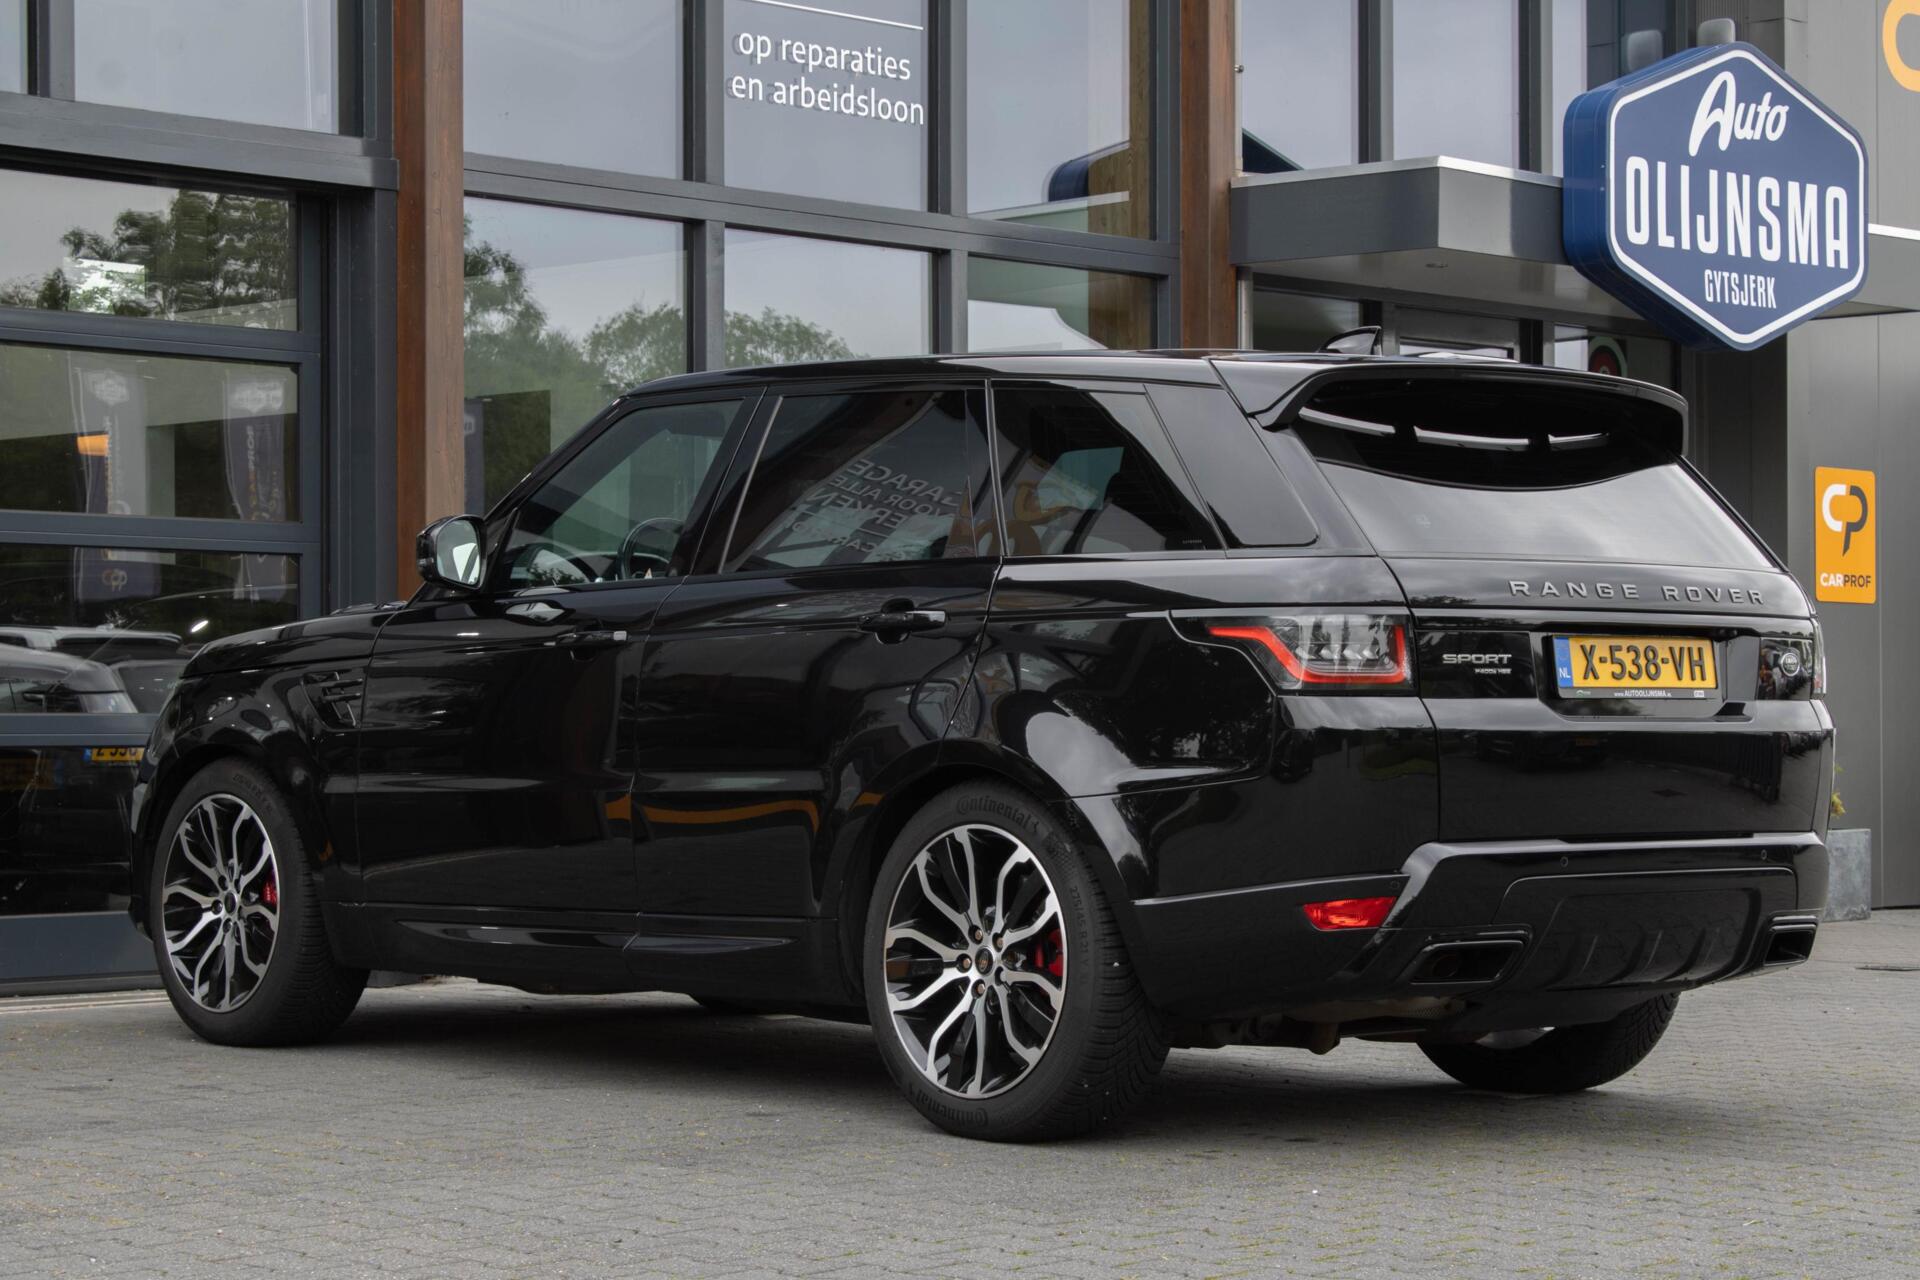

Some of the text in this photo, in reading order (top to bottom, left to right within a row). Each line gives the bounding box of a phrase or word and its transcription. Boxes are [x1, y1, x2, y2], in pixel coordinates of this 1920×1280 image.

[738, 32, 911, 81] op reparaties
[731, 74, 924, 125] en arbeidsloon
[1688, 70, 1790, 157] Auto
[1625, 155, 1849, 270] OLIJNSMA
[1704, 269, 1777, 310] GYTSJERK
[1508, 580, 1765, 605] RANGE ROVER
[1820, 571, 1872, 588] CARPROF
[1442, 653, 1513, 664] SPORT
[1559, 667, 1571, 679] NL
[1579, 644, 1707, 682] X-538-VH
